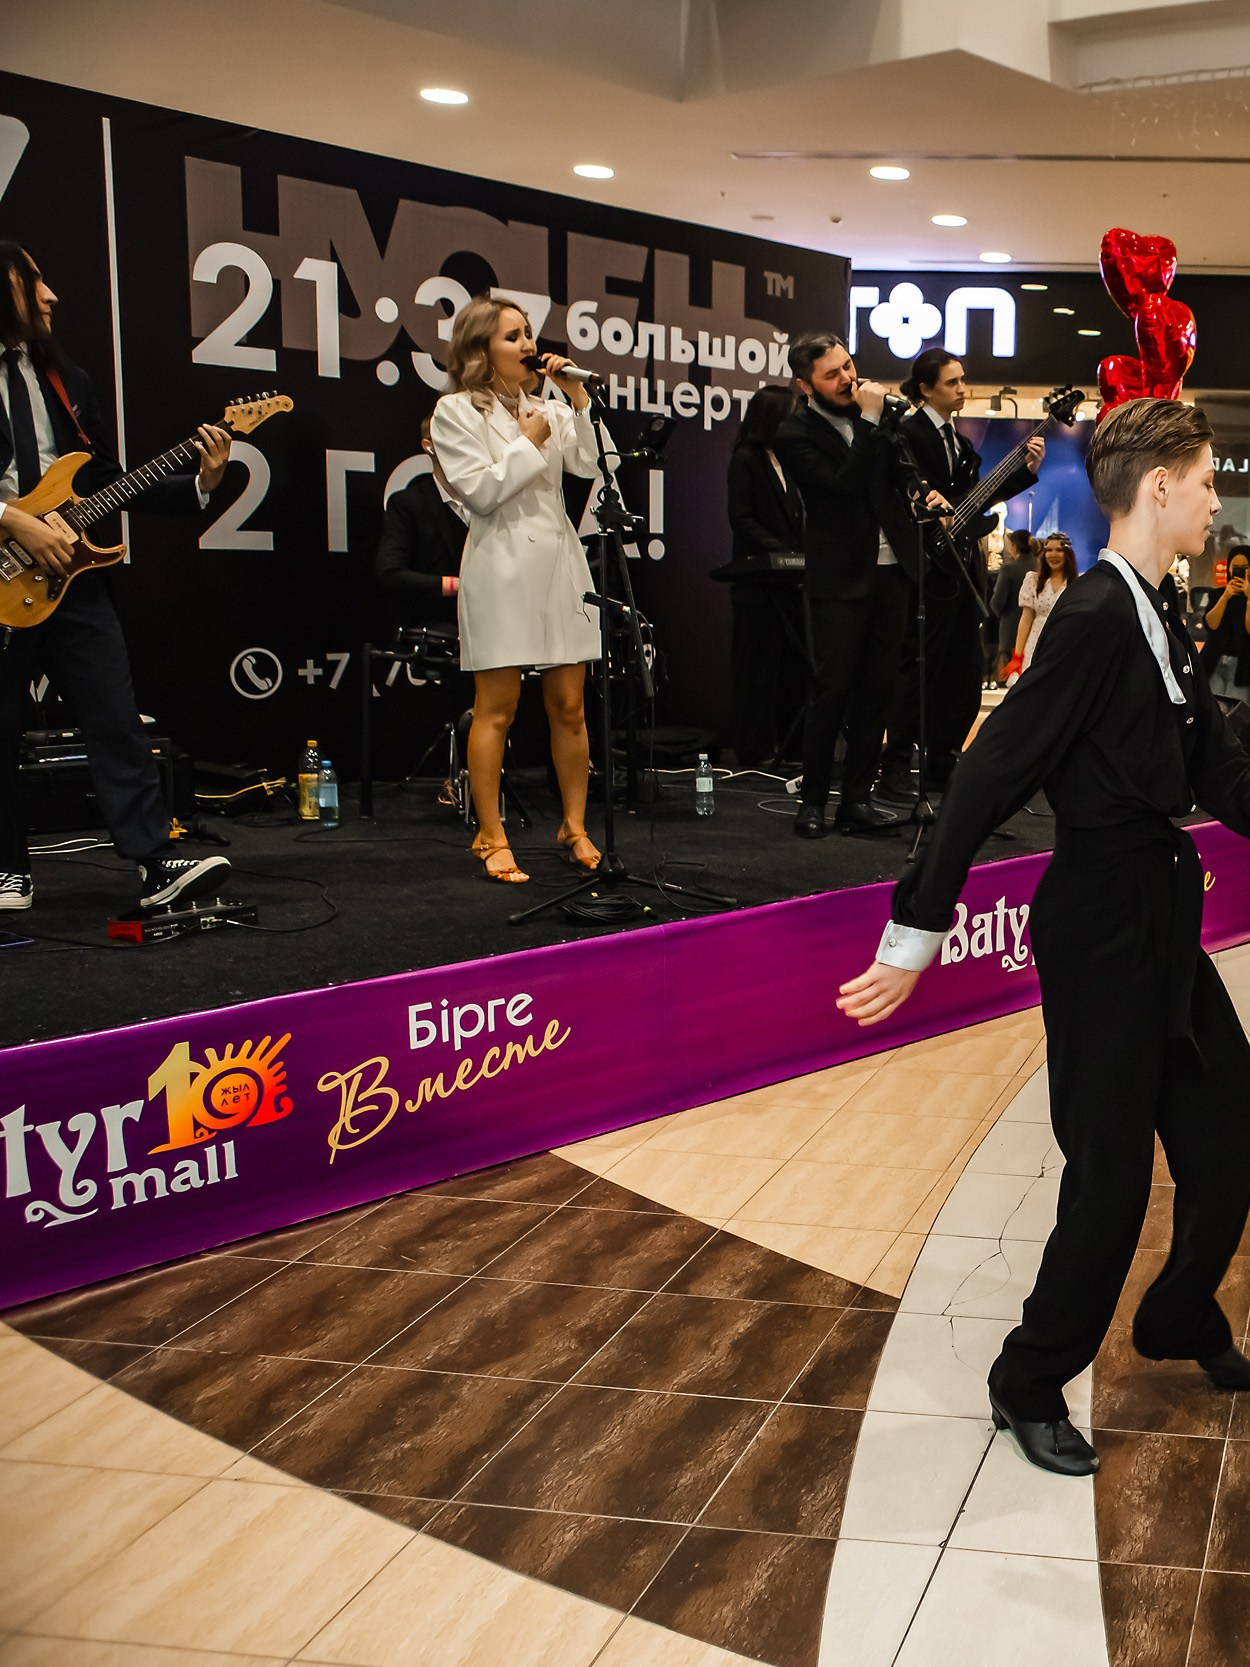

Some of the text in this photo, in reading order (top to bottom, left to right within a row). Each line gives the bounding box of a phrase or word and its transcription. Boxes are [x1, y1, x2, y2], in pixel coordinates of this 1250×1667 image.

[566, 300, 793, 378] большой
[541, 373, 766, 431] нцерт
[199, 440, 274, 550] 2
[298, 653, 350, 690] +7
[408, 993, 533, 1051] Бірге
[221, 1093, 249, 1106] лет
[317, 1019, 571, 1165] Вместе
[108, 1140, 239, 1210] mall
